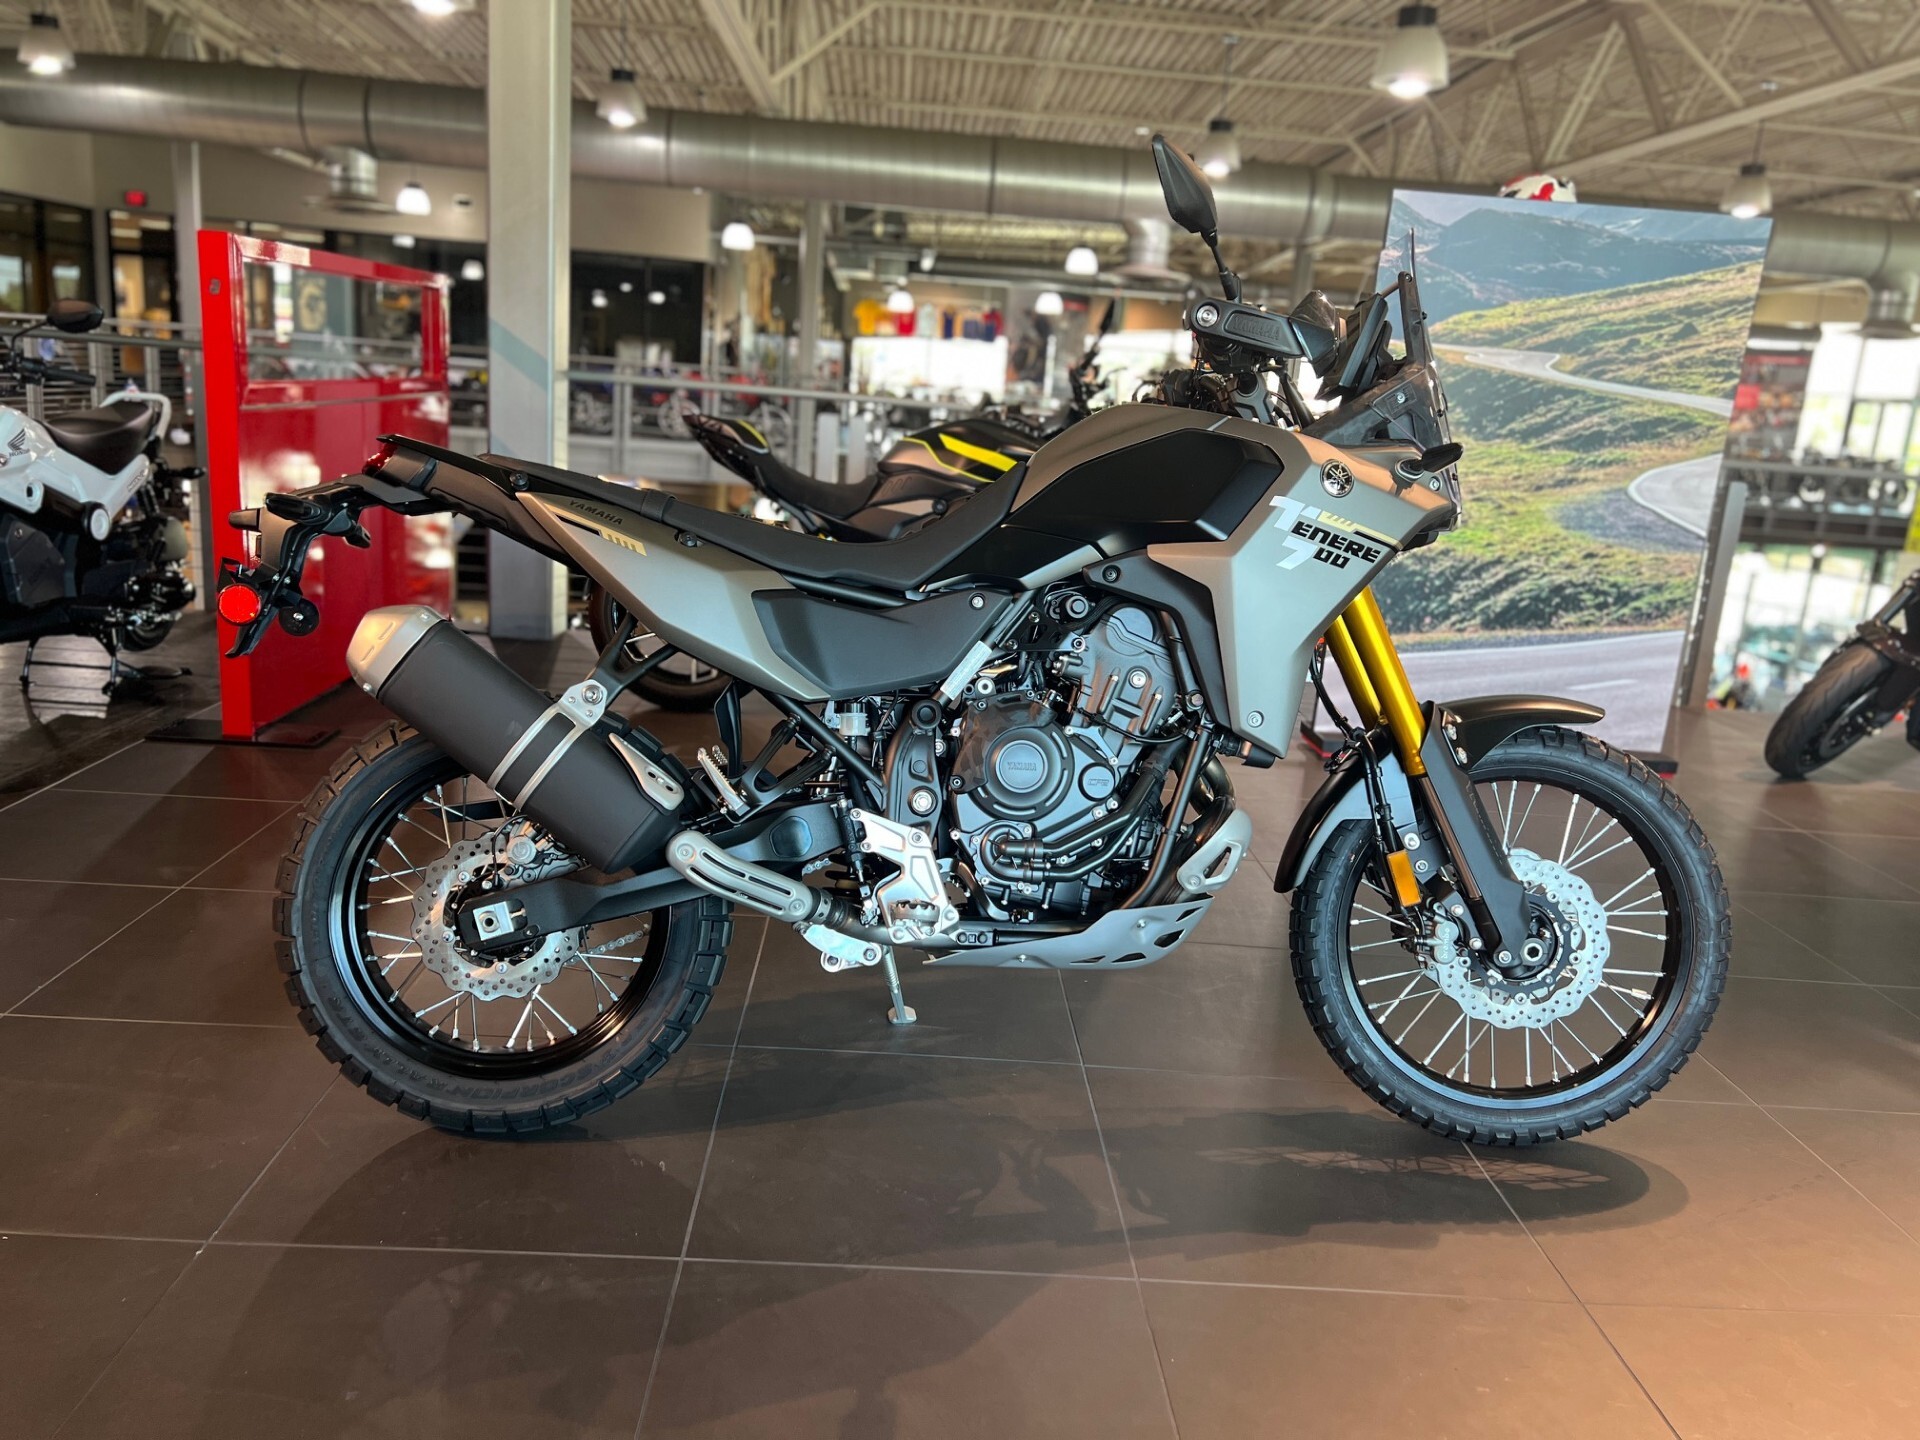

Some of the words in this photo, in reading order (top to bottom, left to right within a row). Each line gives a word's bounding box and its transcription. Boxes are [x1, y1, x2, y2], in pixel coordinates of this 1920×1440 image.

[1234, 316, 1280, 341] YAMAHA
[569, 500, 624, 525] YAMAHA
[1440, 927, 1451, 959] brembo
[446, 1062, 594, 1099] SCORPION
